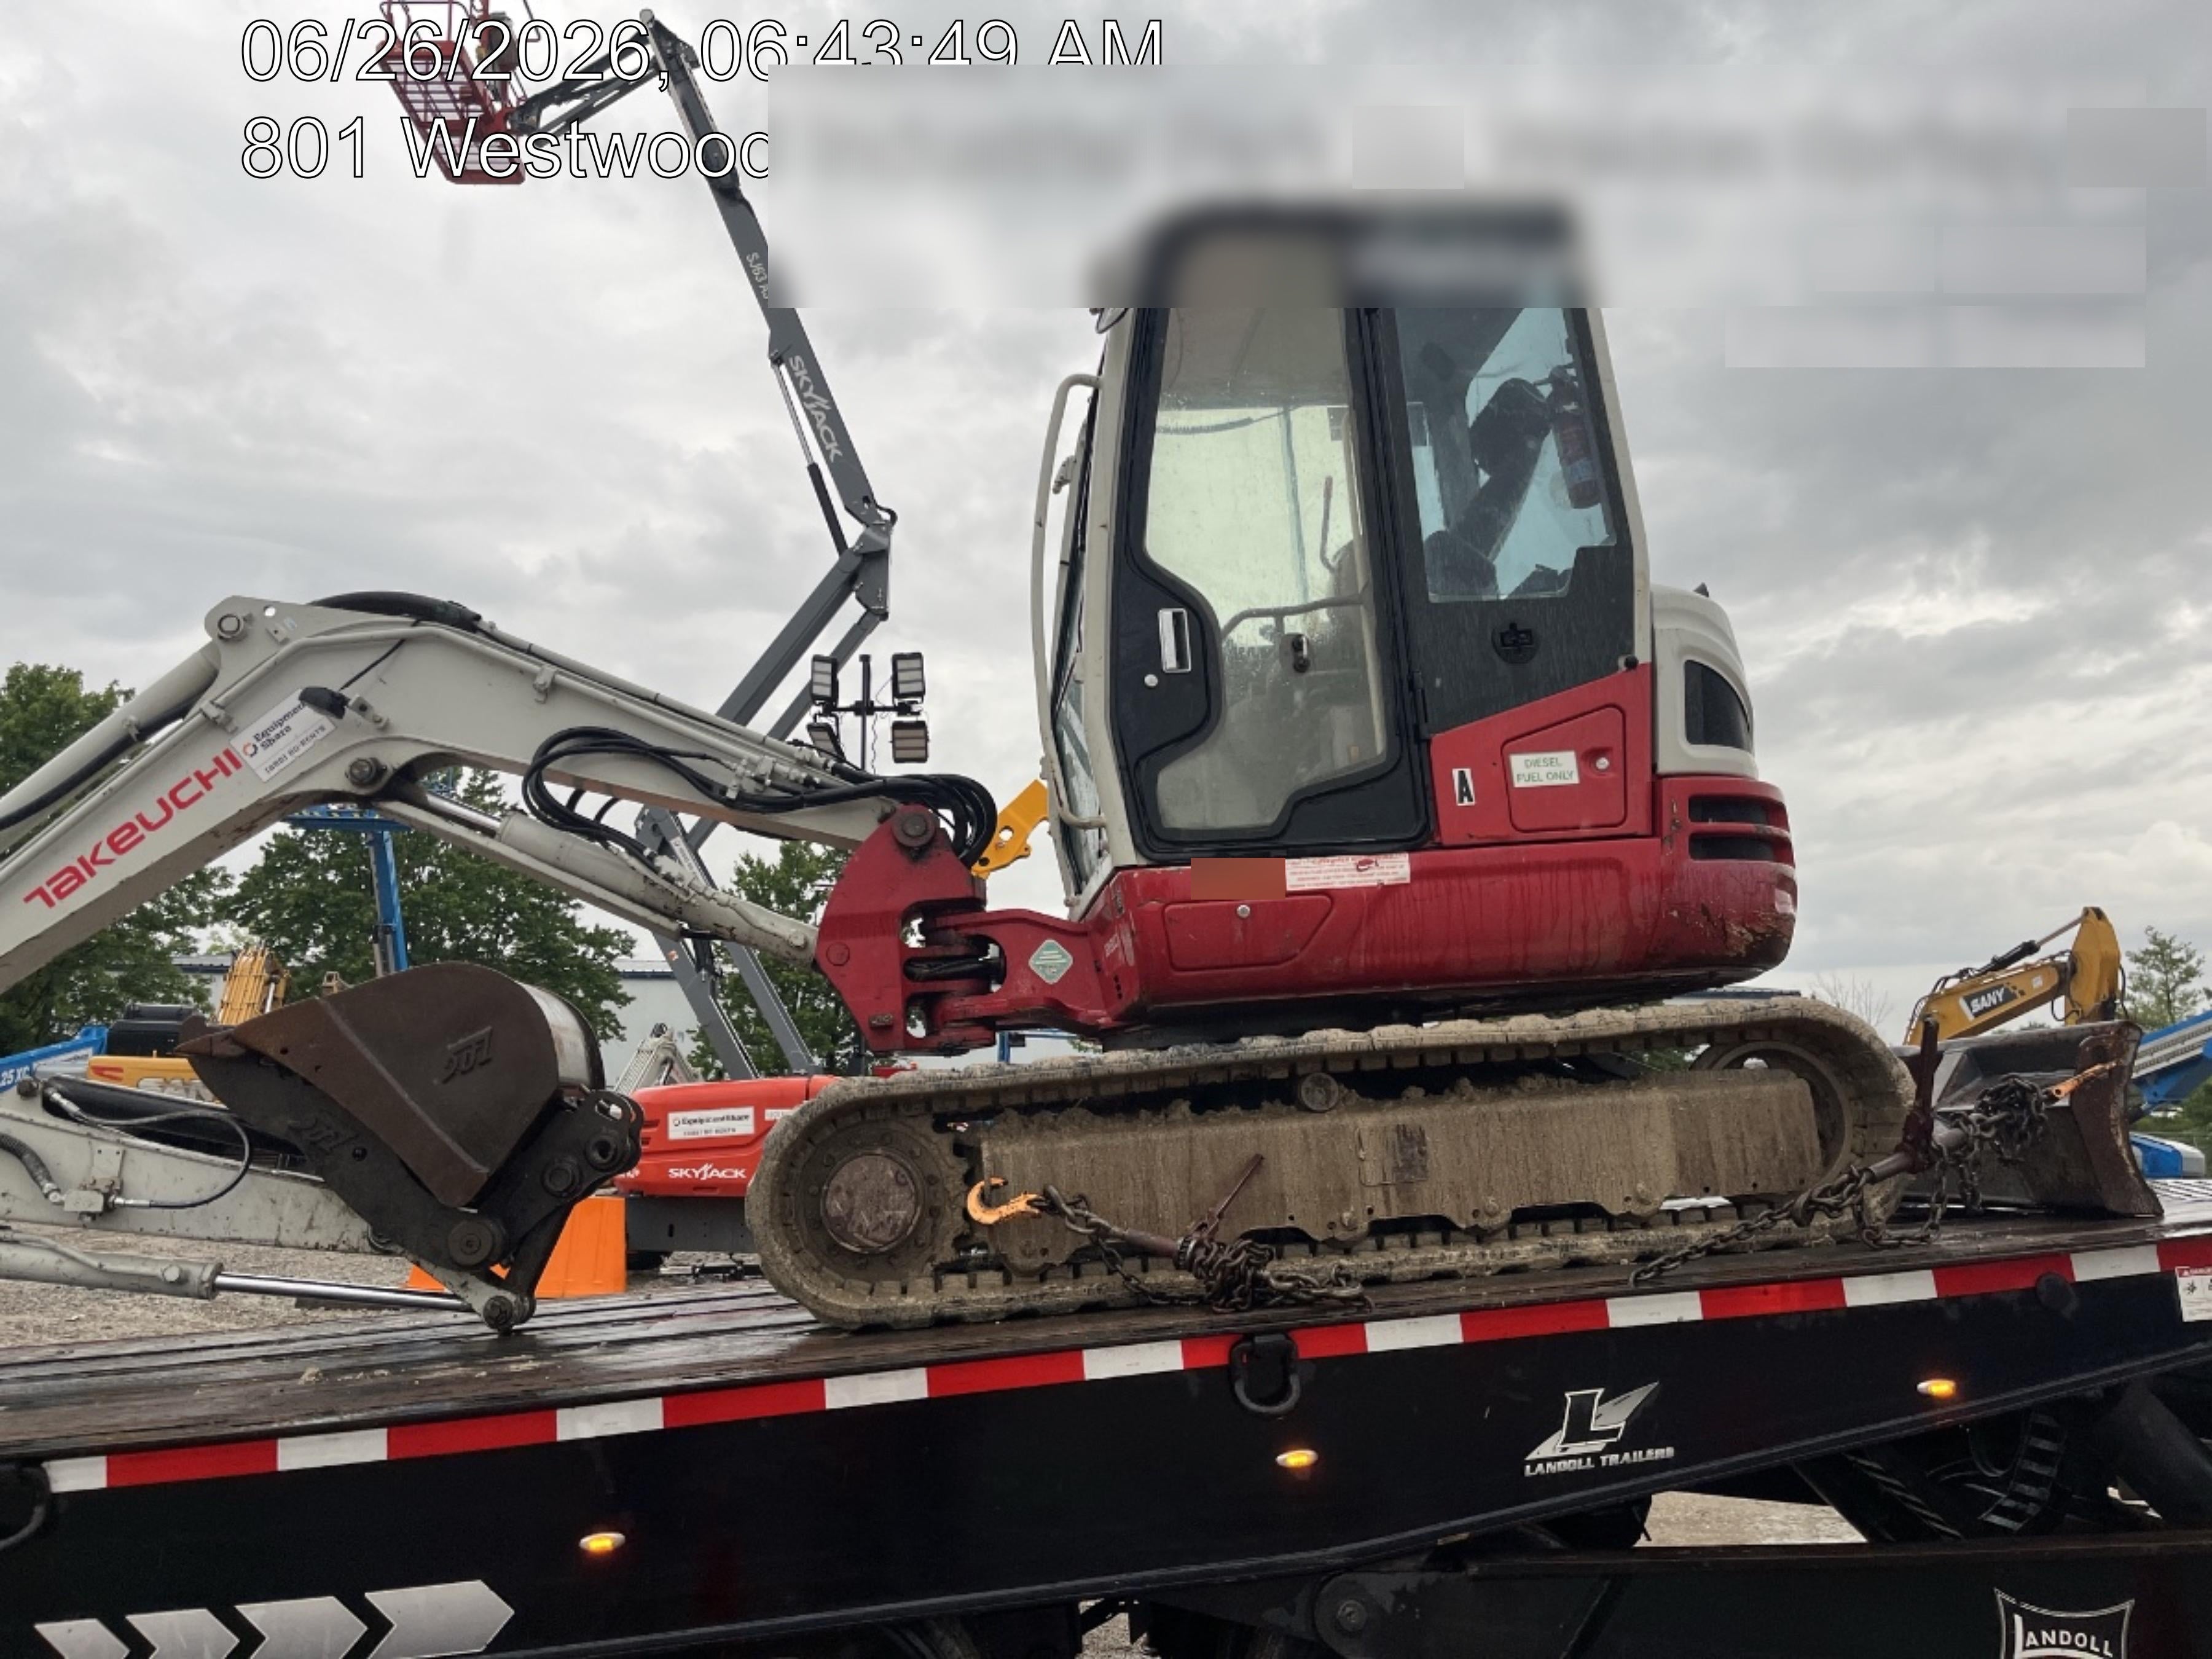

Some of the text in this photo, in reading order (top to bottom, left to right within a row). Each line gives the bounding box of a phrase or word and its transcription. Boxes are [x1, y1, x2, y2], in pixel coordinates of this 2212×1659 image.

[788, 355, 843, 463] SKYJACK
[1516, 770, 1575, 783] FUEL ONLY
[1524, 756, 1563, 769] DIESEL
[1457, 769, 1474, 804] A
[1970, 987, 2005, 1014] SANY
[668, 1163, 747, 1181] SKYJACK
[1523, 1446, 1675, 1477] LANDOLL TRAILERS
[2013, 1613, 2114, 1659] LANDOLL
